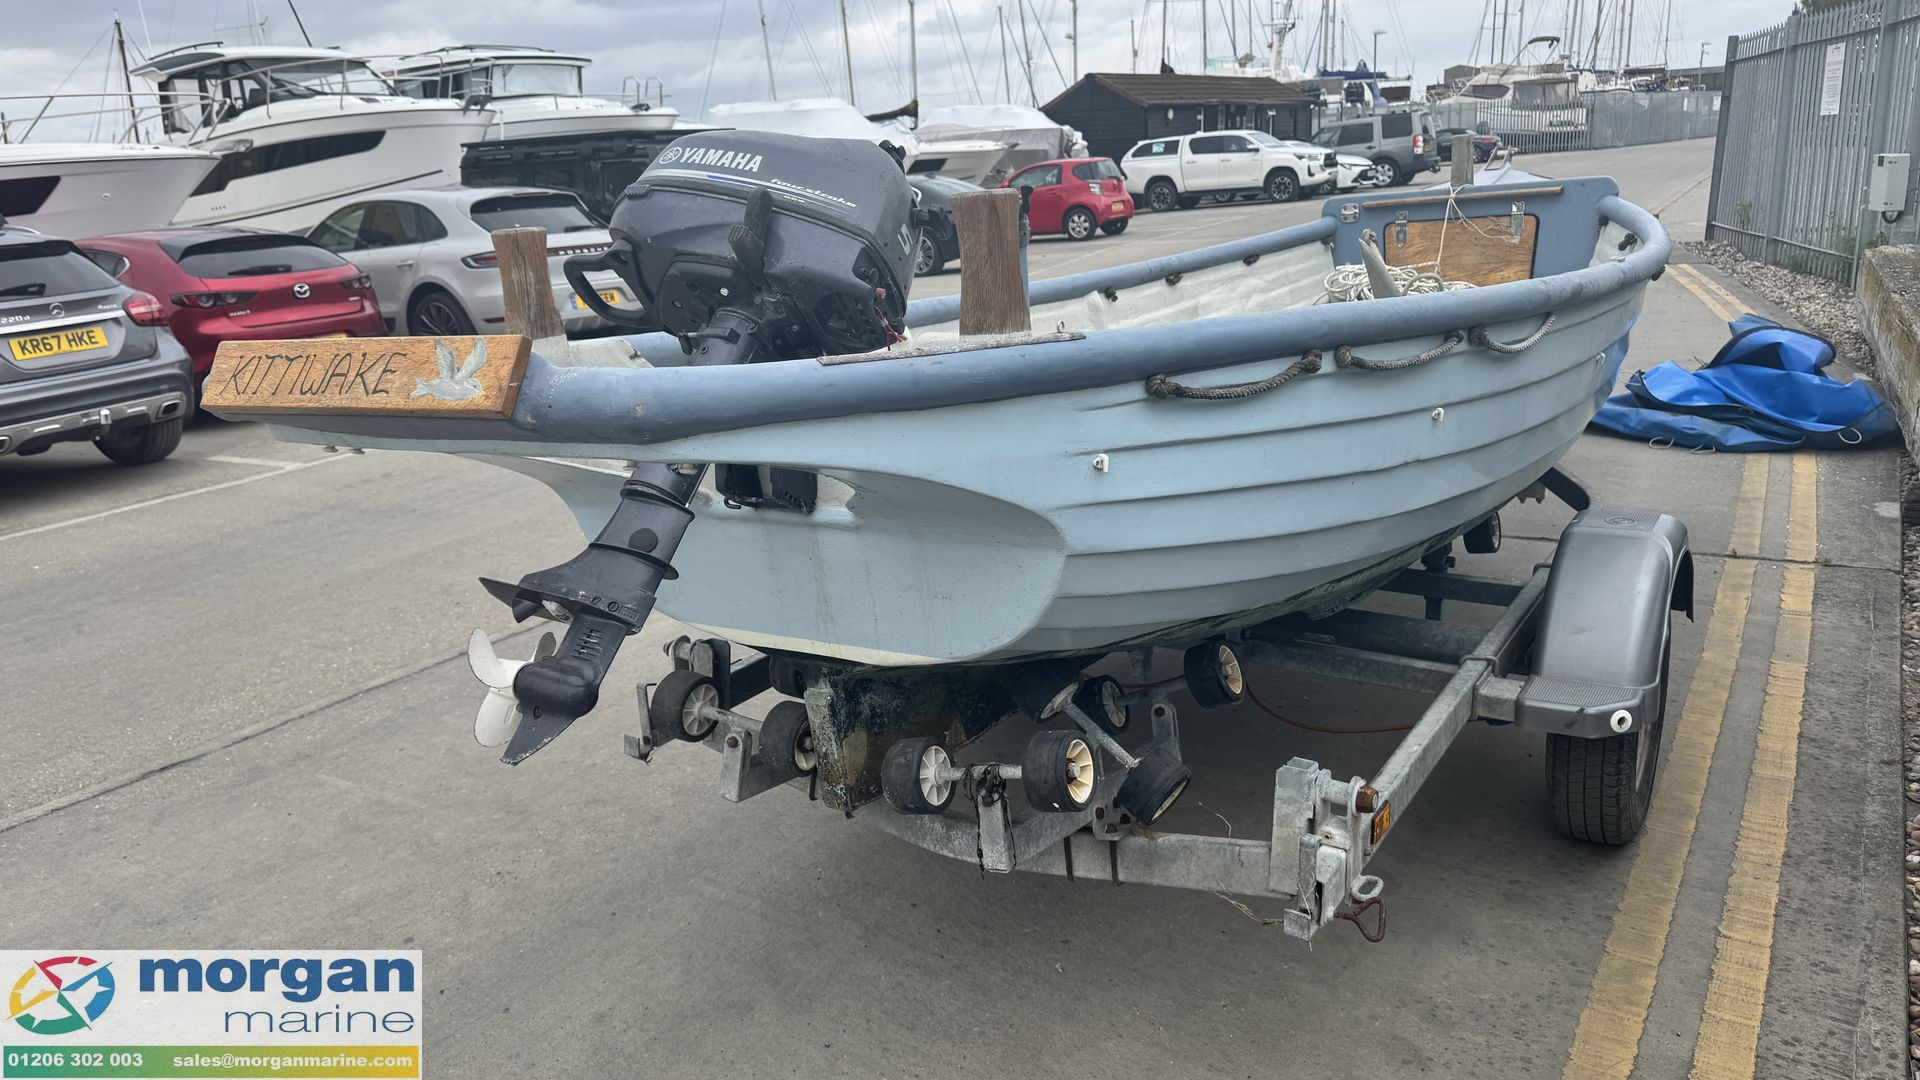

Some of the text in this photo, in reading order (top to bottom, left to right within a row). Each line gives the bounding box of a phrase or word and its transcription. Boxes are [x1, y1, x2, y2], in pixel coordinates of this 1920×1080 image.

[680, 147, 763, 173] YAMAHA
[897, 223, 913, 256] 5
[17, 330, 99, 356] KR67 HKE
[219, 351, 407, 397] KITTIWAKE
